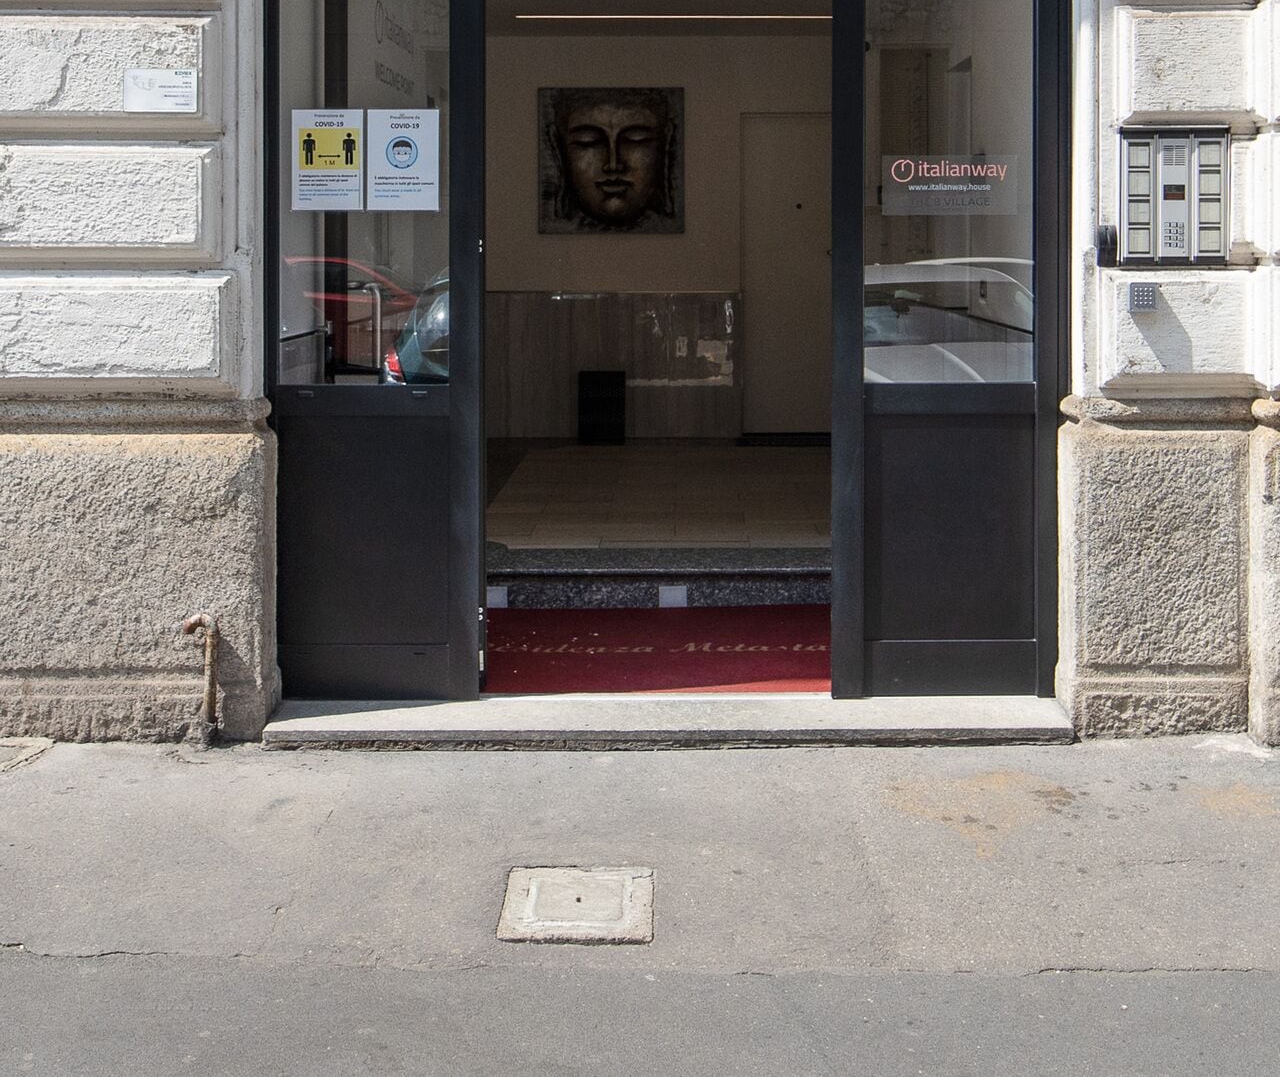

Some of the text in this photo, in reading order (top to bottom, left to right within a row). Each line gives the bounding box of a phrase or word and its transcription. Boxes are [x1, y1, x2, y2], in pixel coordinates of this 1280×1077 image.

[390, 122, 420, 130] COVID-19
[918, 160, 1008, 181] italianway
[908, 183, 991, 192] www.italianway.house
[943, 197, 991, 206] VILLAGE
[488, 641, 831, 654] esidenza Metasta
